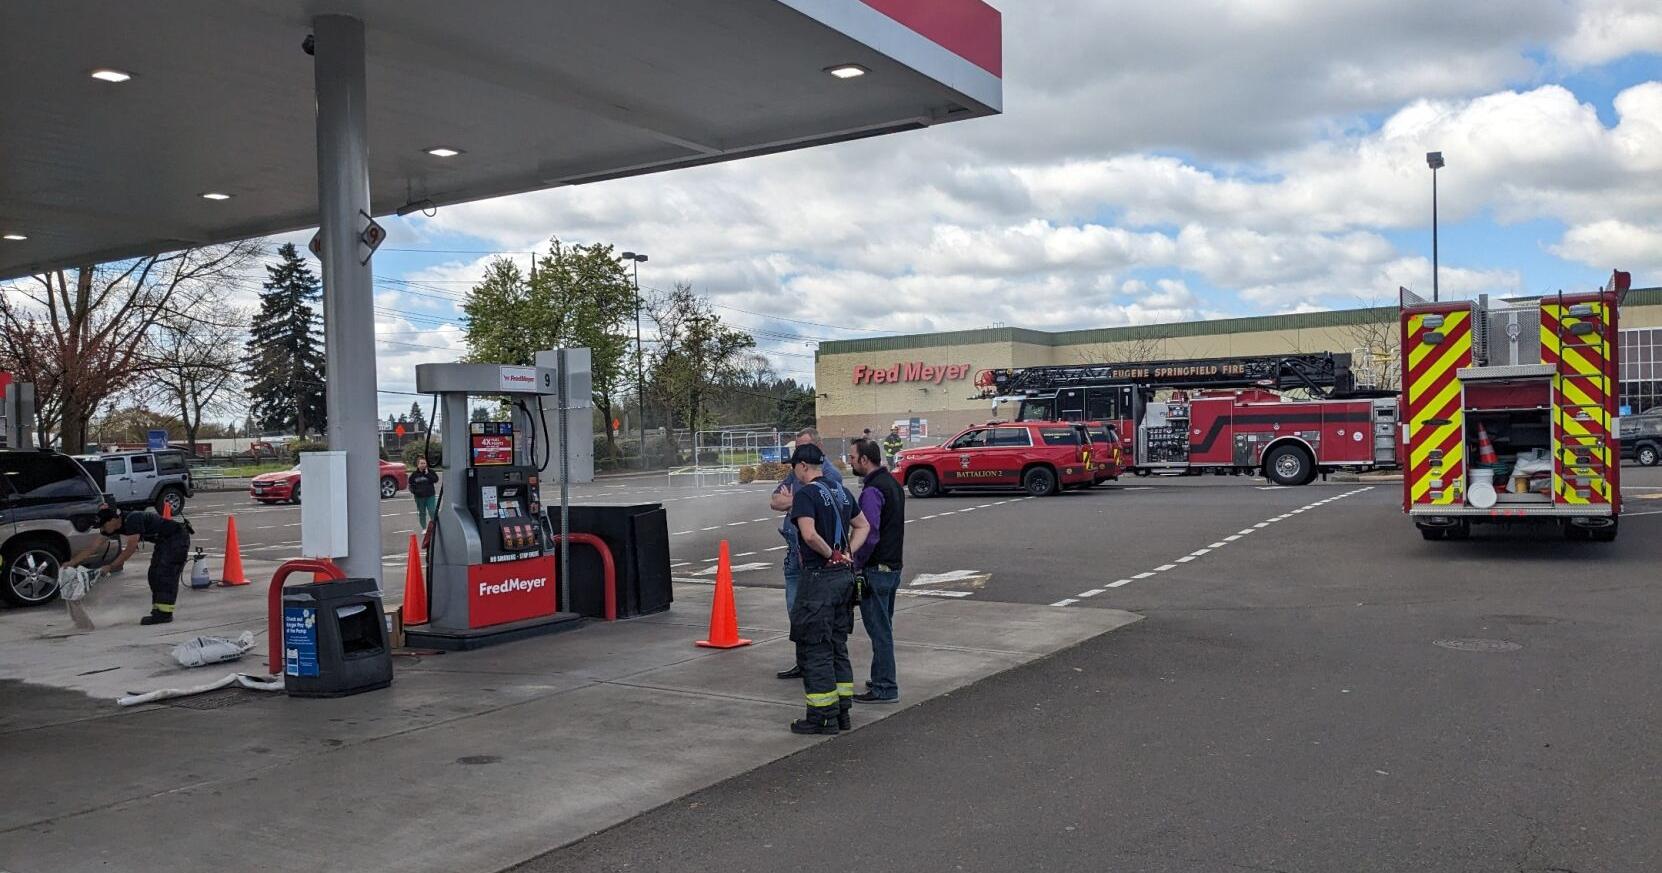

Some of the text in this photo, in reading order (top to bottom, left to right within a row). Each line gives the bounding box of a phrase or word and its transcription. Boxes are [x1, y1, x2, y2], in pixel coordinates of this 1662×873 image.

[370, 227, 378, 244] 9
[852, 361, 970, 385] Fred Meyer
[1112, 364, 1245, 378] EUGENE SPRINGFIELD FIRE
[544, 373, 551, 387] 9
[956, 470, 997, 478] BATTALION
[479, 577, 547, 597] FredMeyer
